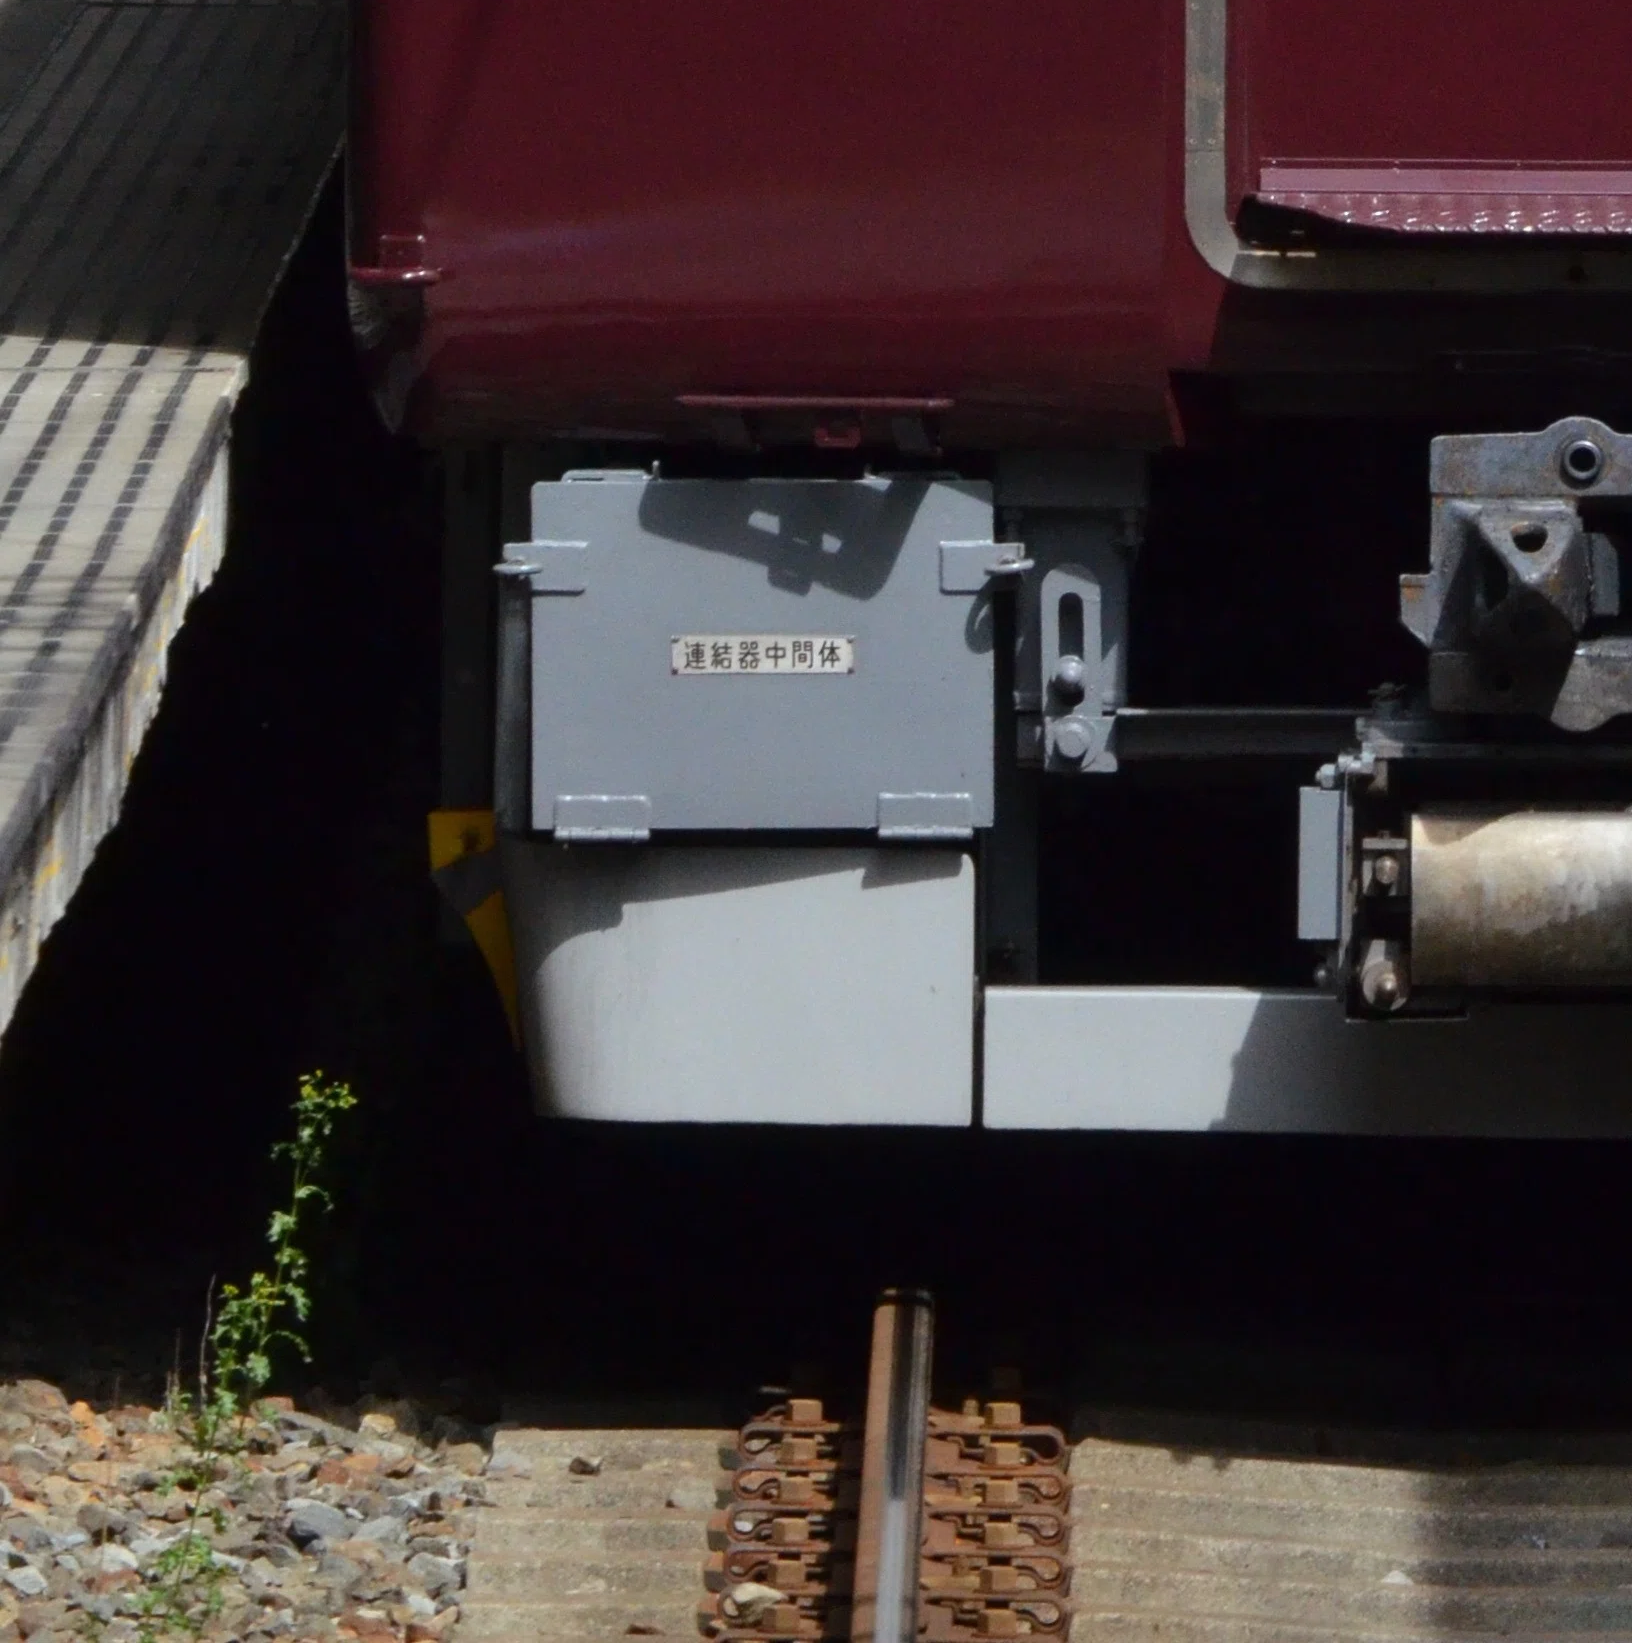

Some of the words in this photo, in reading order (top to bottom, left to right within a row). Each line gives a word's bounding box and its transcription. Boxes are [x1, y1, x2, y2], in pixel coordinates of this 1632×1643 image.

[683, 640, 841, 670] 連結器中間体
